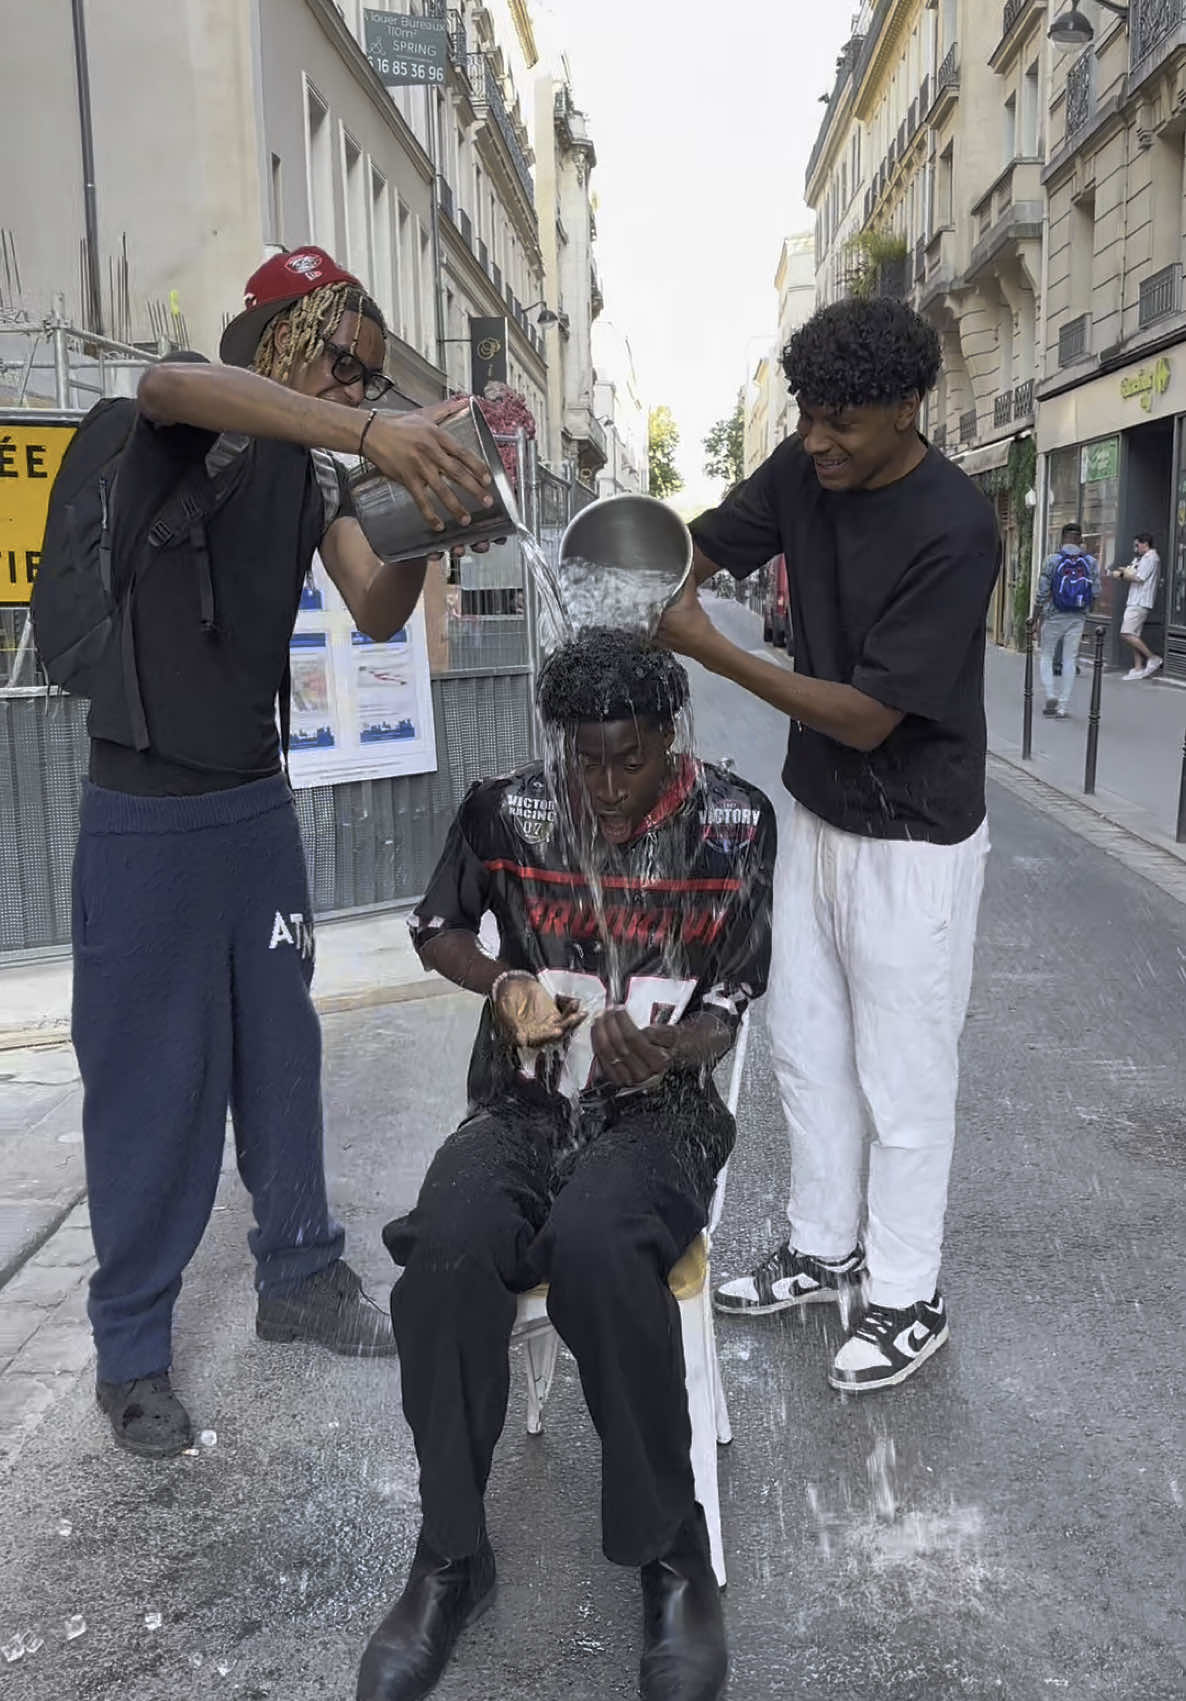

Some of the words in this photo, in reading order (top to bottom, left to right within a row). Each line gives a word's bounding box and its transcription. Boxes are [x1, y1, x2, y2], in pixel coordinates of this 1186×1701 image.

[401, 16, 446, 32] Bureaux
[392, 40, 437, 57] SPRING
[377, 57, 390, 73] 16
[392, 60, 408, 76] 85
[411, 63, 426, 79] 36
[428, 66, 444, 82] 96
[698, 807, 760, 826] VICTORY
